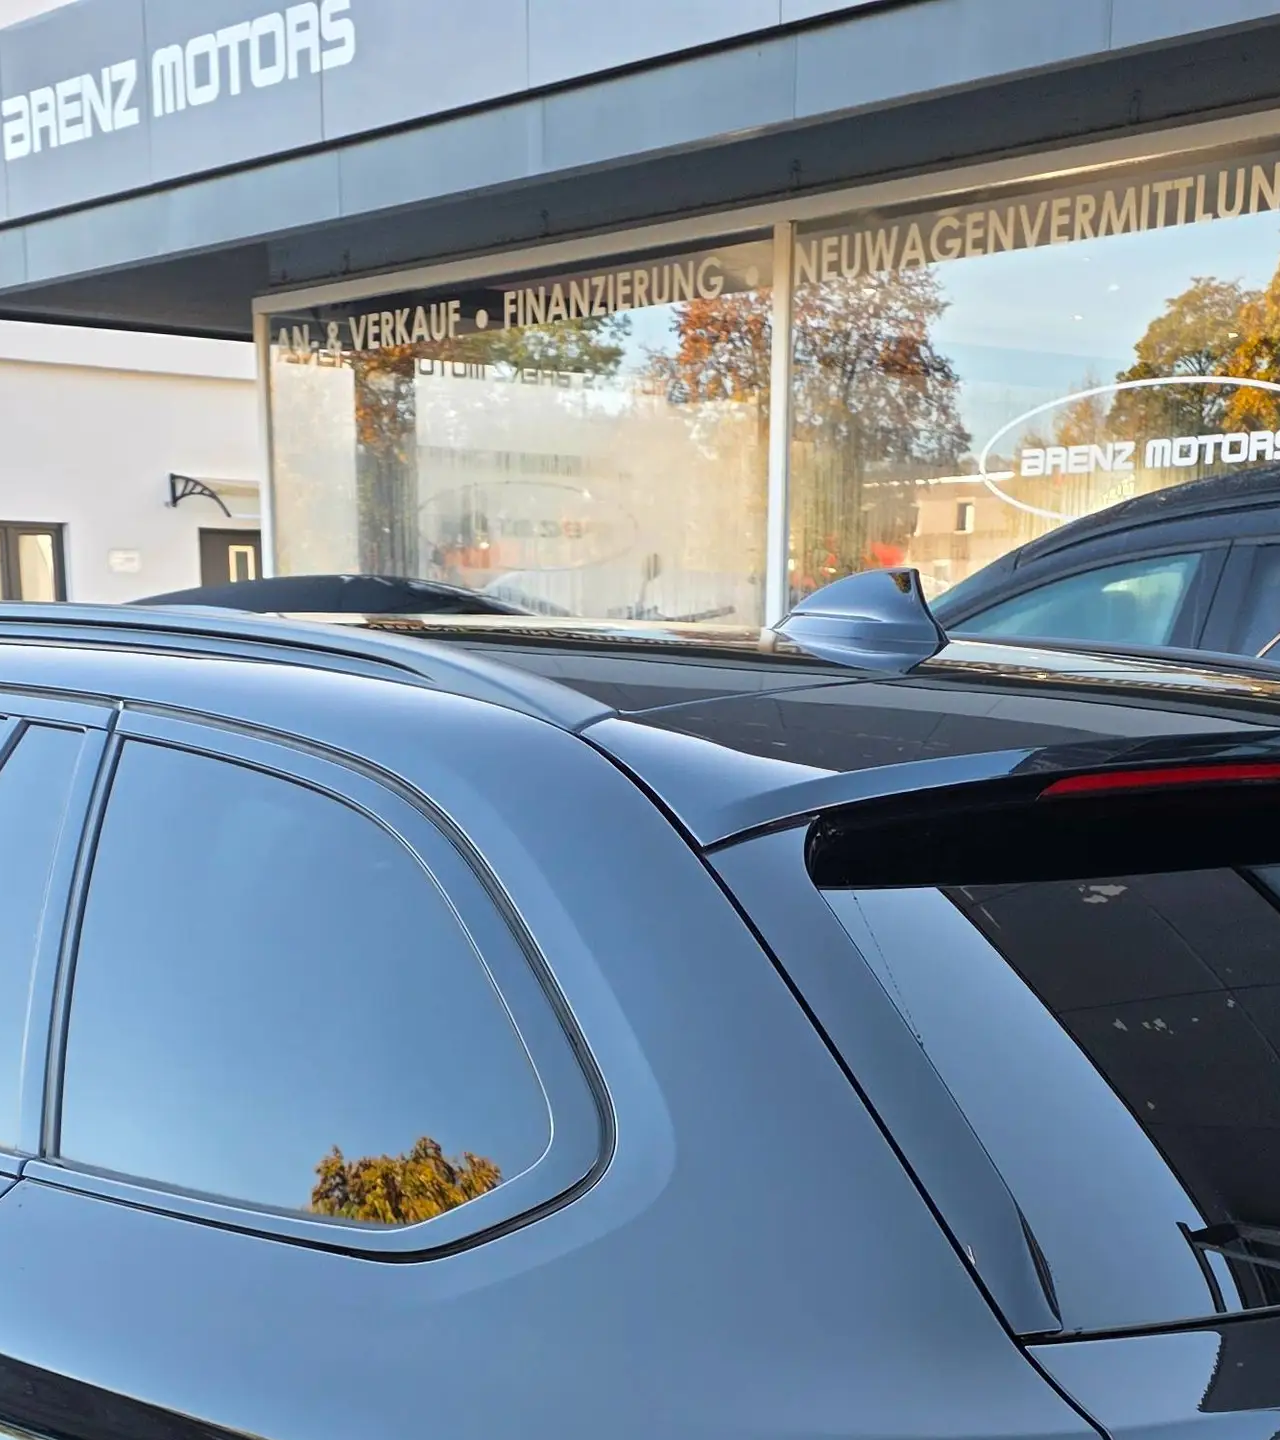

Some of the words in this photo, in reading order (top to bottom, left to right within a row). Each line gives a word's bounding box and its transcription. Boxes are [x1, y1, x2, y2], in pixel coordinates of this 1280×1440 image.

[2, 58, 140, 161] BRENZ
[152, 0, 355, 117] MOTORS
[326, 321, 343, 352] &
[348, 300, 460, 351] VERKAUF
[503, 255, 724, 329] FINANZIERUNG
[1021, 441, 1136, 477] BRENZ
